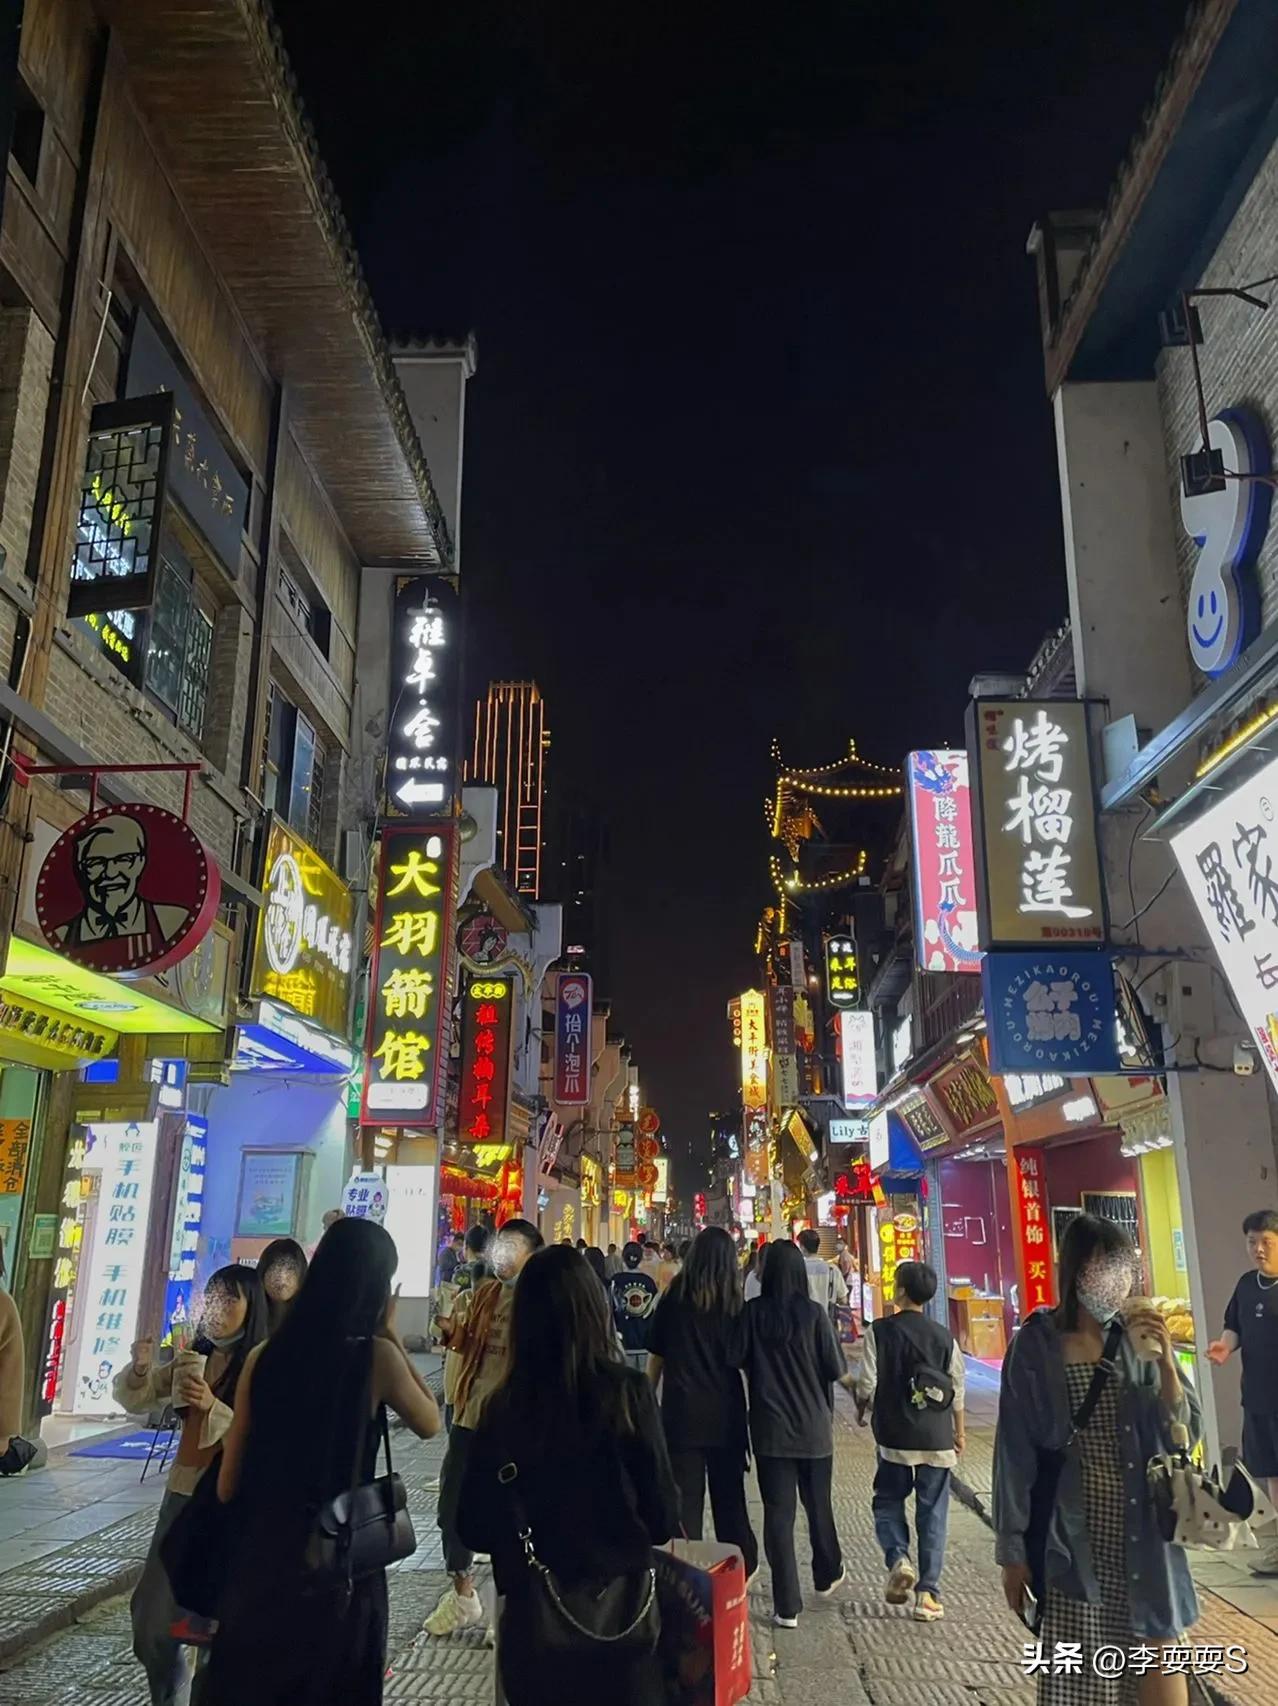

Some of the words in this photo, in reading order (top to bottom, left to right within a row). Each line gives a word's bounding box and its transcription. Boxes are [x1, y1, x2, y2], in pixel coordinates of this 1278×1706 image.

[932, 795, 967, 906] 降龍爪爪
[1003, 710, 1094, 918] 烤榴莲
[372, 850, 441, 1081] 大羽箭馆
[4, 1121, 30, 1193] 全部清仓
[832, 1125, 855, 1138] Lily
[104, 1158, 141, 1247] 手机贴膜
[347, 1187, 370, 1203] 专业
[1020, 1157, 1044, 1245] 纯银首饰
[92, 1263, 130, 1356] 手机维修
